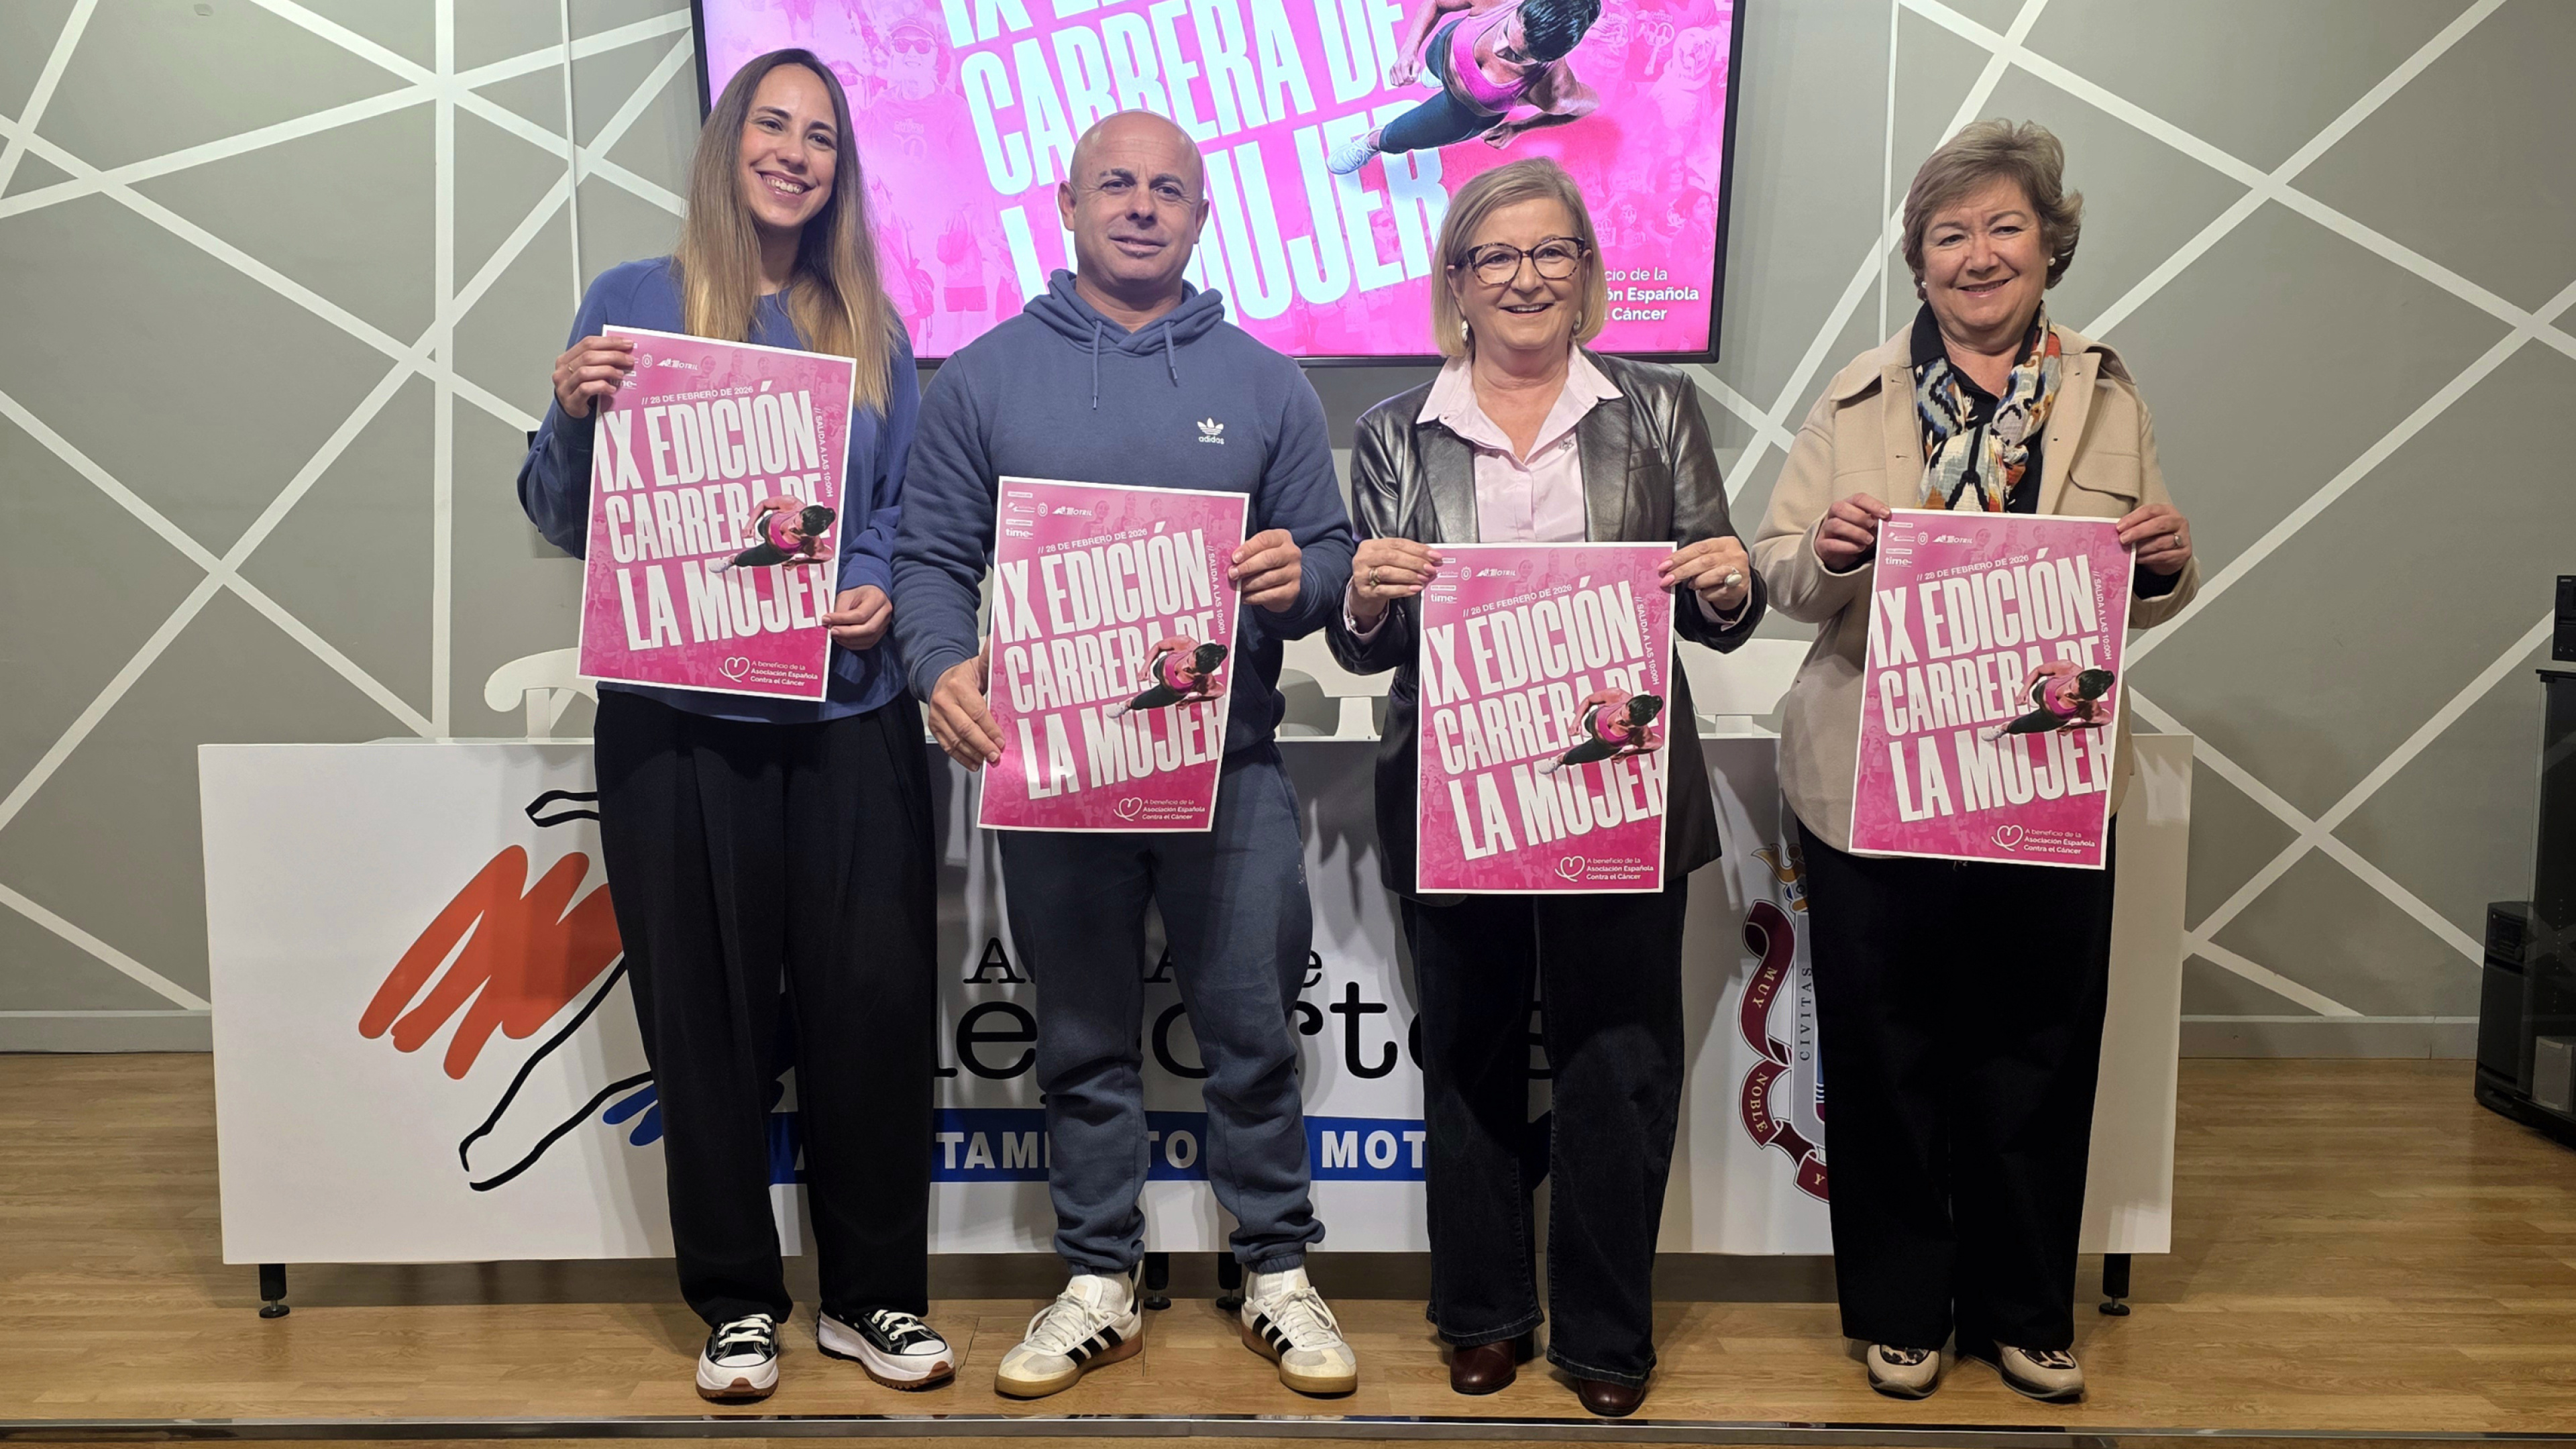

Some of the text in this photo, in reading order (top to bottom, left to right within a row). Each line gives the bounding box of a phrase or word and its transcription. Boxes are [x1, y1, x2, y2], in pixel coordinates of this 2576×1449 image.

[1627, 286, 1699, 304] Española
[1629, 268, 1650, 281] de
[1654, 267, 1668, 281] la
[1612, 307, 1667, 321] Cáncer
[650, 396, 661, 405] 28
[662, 394, 675, 402] DE
[677, 390, 718, 401] FEBRERO
[720, 388, 733, 396] DE
[734, 386, 753, 394] 2026
[595, 380, 820, 492] IX EDICIÓN
[816, 415, 826, 445] SALIDA
[821, 454, 829, 470] LAS
[1198, 435, 1224, 445] adidas
[1045, 545, 1056, 553] 28
[1057, 541, 1070, 551] DE
[1071, 535, 1112, 549] FEBRERO
[1114, 531, 1127, 540] DE
[1128, 528, 1148, 539] 2026
[994, 521, 1213, 644] IX EDICIÓN
[1208, 553, 1218, 583] SALIDA
[1214, 592, 1222, 607] LAS
[1937, 569, 1949, 578] DE
[1951, 561, 1993, 576] FEBRERO
[1995, 558, 2008, 567] DE
[2008, 555, 2029, 564] 2026
[616, 565, 682, 651] LA
[1483, 603, 1495, 612] DE
[1497, 592, 1537, 609] FEBRERO
[1539, 588, 1552, 598] DE
[1552, 584, 1572, 595] 2026
[1869, 547, 2098, 669] IX EDICIÓN
[2094, 578, 2104, 608] SALIDA
[2099, 616, 2108, 633] LAS
[1422, 575, 1645, 708] IX EDICIÓN
[1637, 604, 1649, 634] SALIDA
[1645, 641, 1654, 658] LAS
[751, 668, 818, 680] Asociación Española
[782, 678, 805, 686] Cáncer
[1017, 713, 1080, 800] LA
[1888, 735, 1954, 823] LA
[1448, 772, 1517, 861] LA
[2023, 844, 2047, 852] Contra
[2056, 847, 2082, 855] Cáncer
[2024, 836, 2096, 847] Asociación Española
[1623, 865, 1654, 873] Española
[1753, 966, 1778, 1008] MUY
[1799, 967, 1812, 1061] CIVITAS
[1750, 1071, 1768, 1134] NOBLE
[1813, 1172, 1827, 1186] Y
